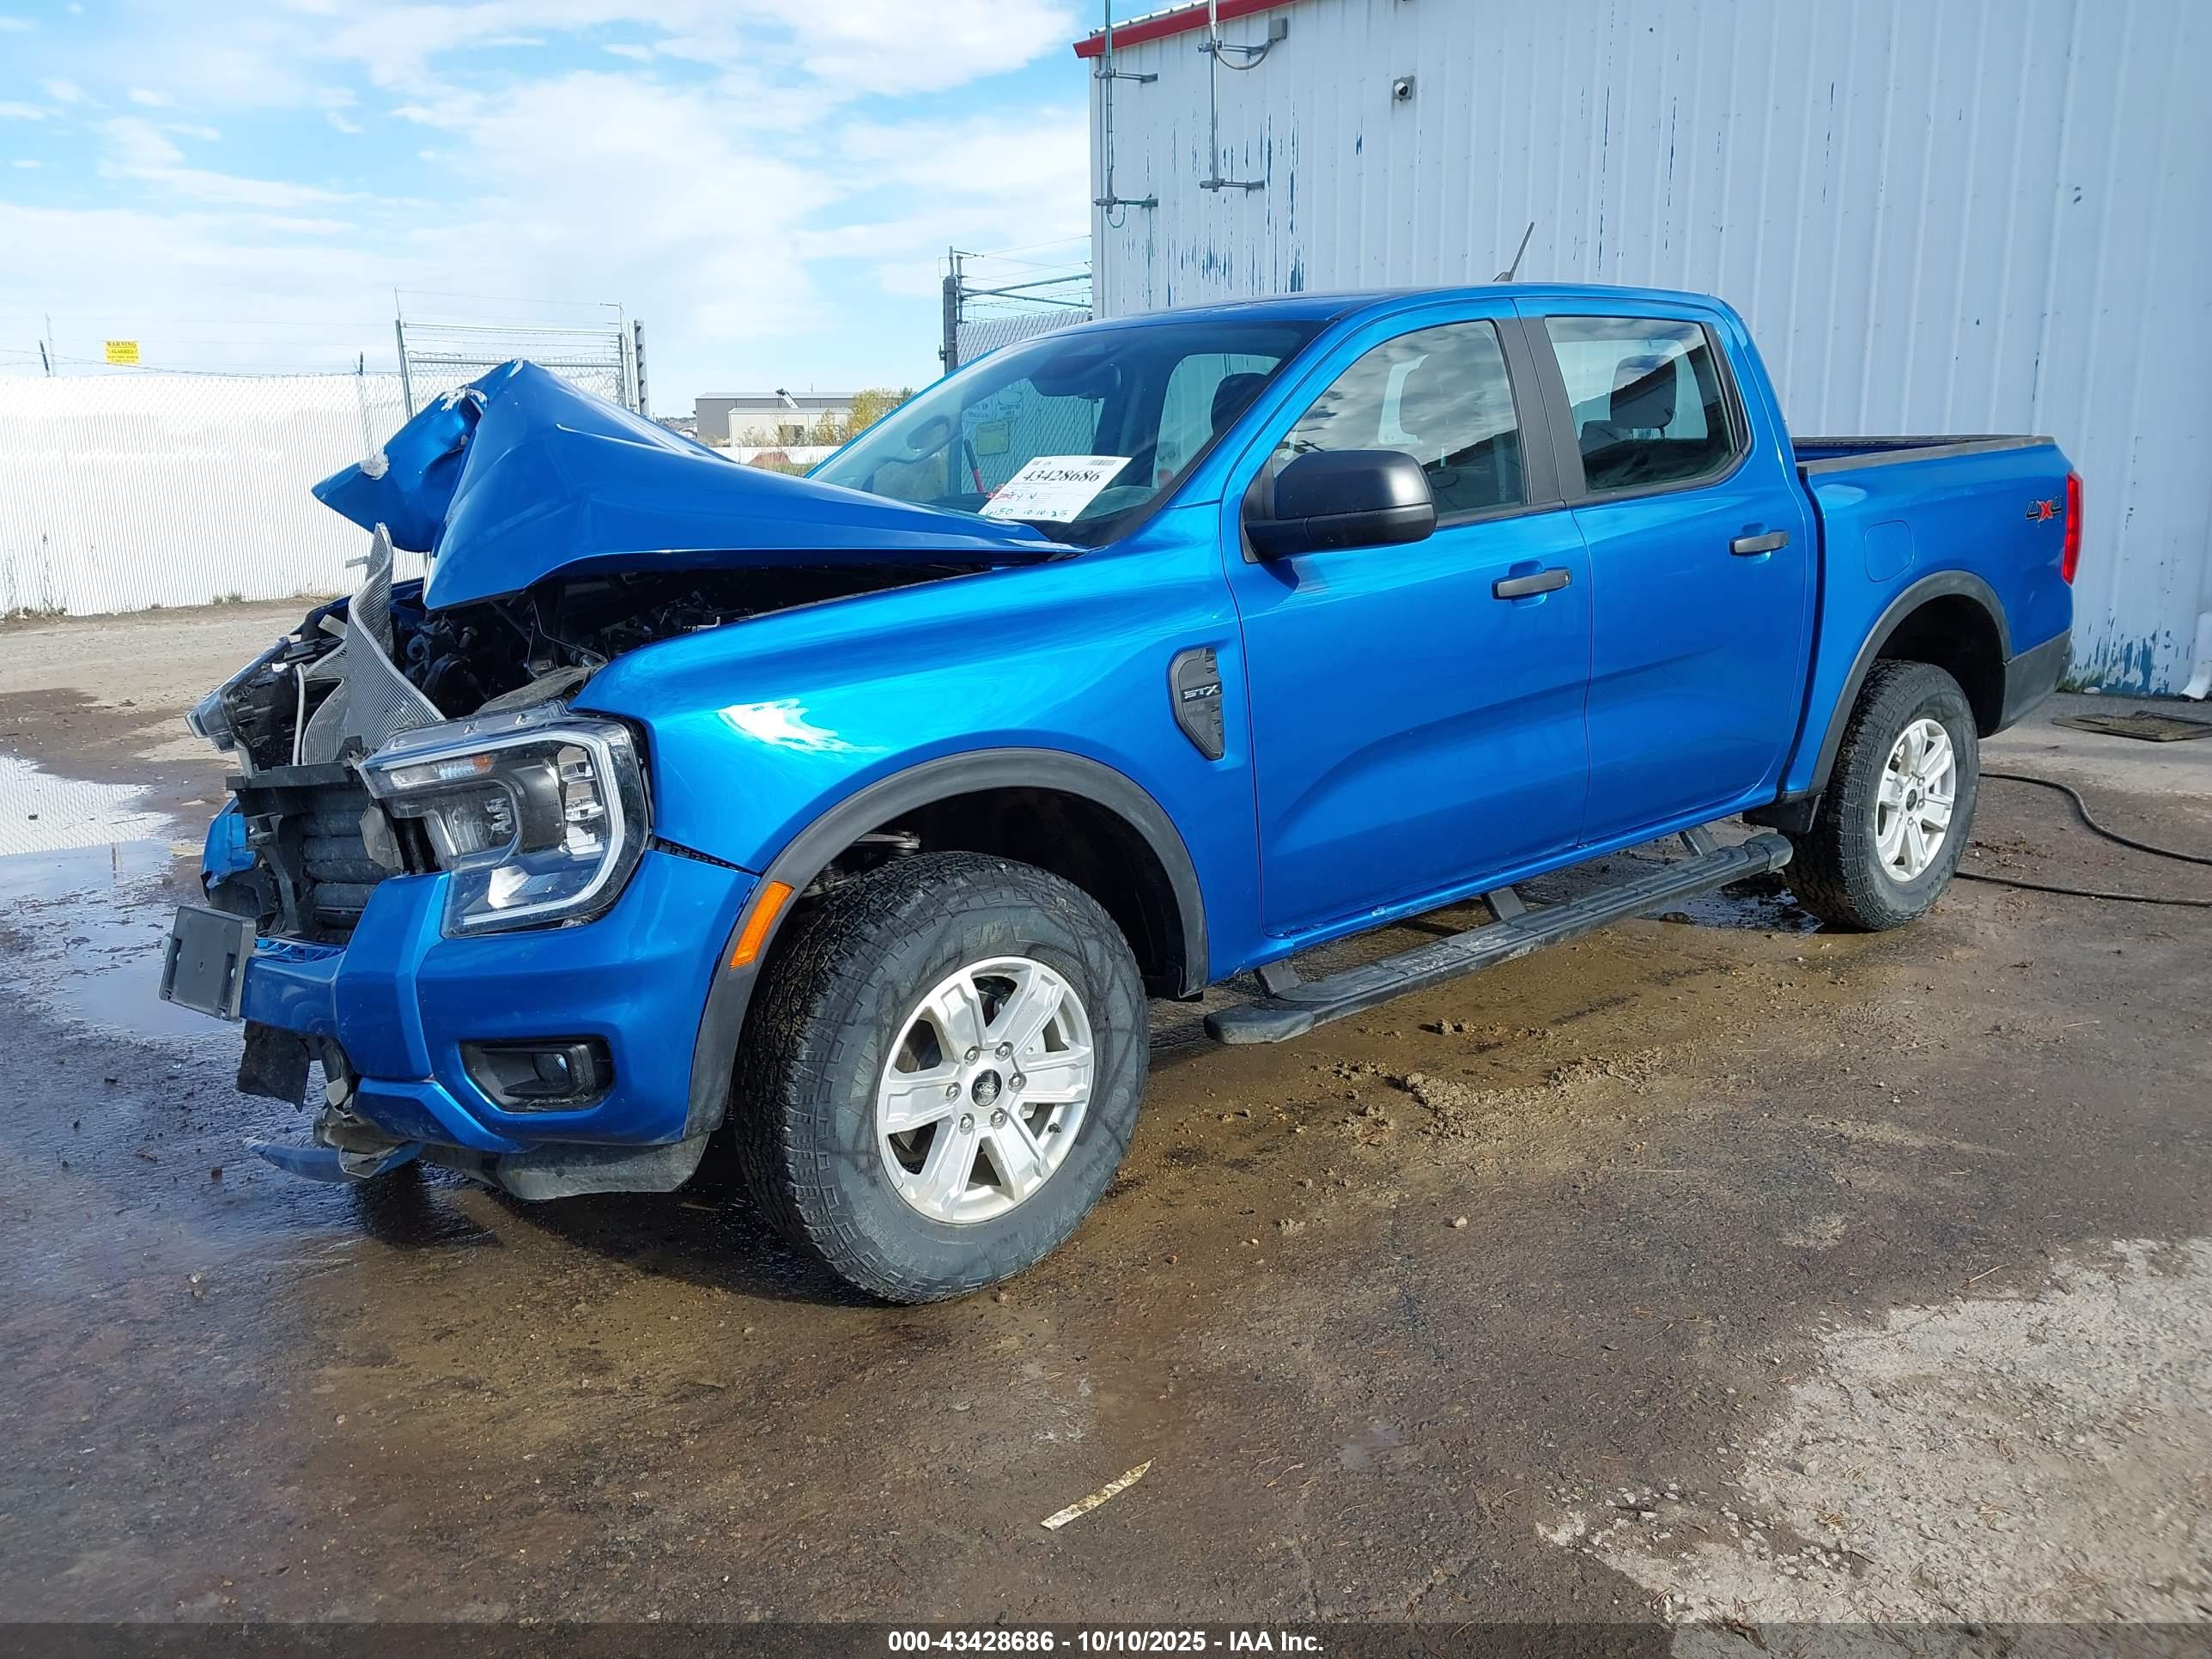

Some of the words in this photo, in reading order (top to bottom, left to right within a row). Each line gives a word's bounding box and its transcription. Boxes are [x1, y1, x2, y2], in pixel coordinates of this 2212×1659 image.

[1024, 470, 1105, 482] 43428686
[1184, 684, 1218, 700] STX
[979, 1084, 995, 1094] Ford
